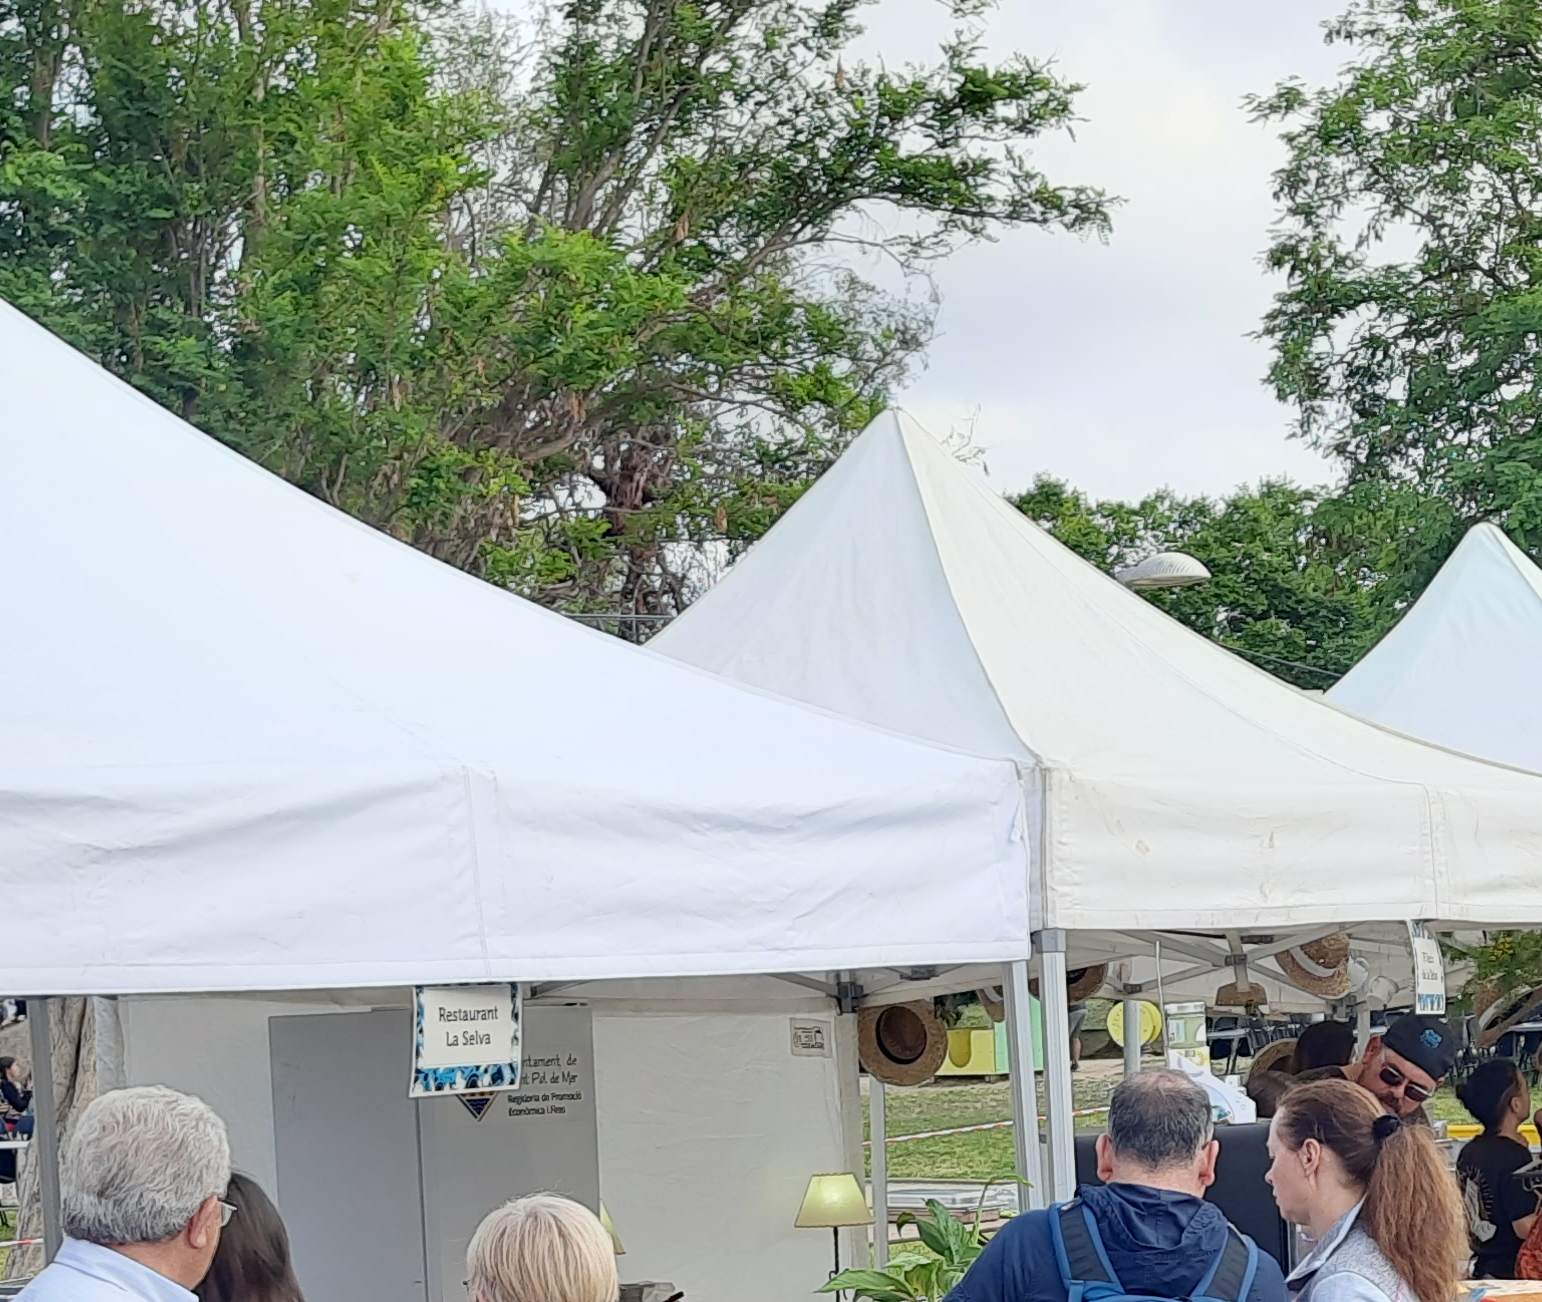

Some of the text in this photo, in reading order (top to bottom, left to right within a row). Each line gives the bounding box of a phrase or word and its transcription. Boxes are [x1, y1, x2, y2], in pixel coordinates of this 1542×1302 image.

[438, 1005, 499, 1023] Restaurant
[446, 1029, 492, 1047] La Selva
